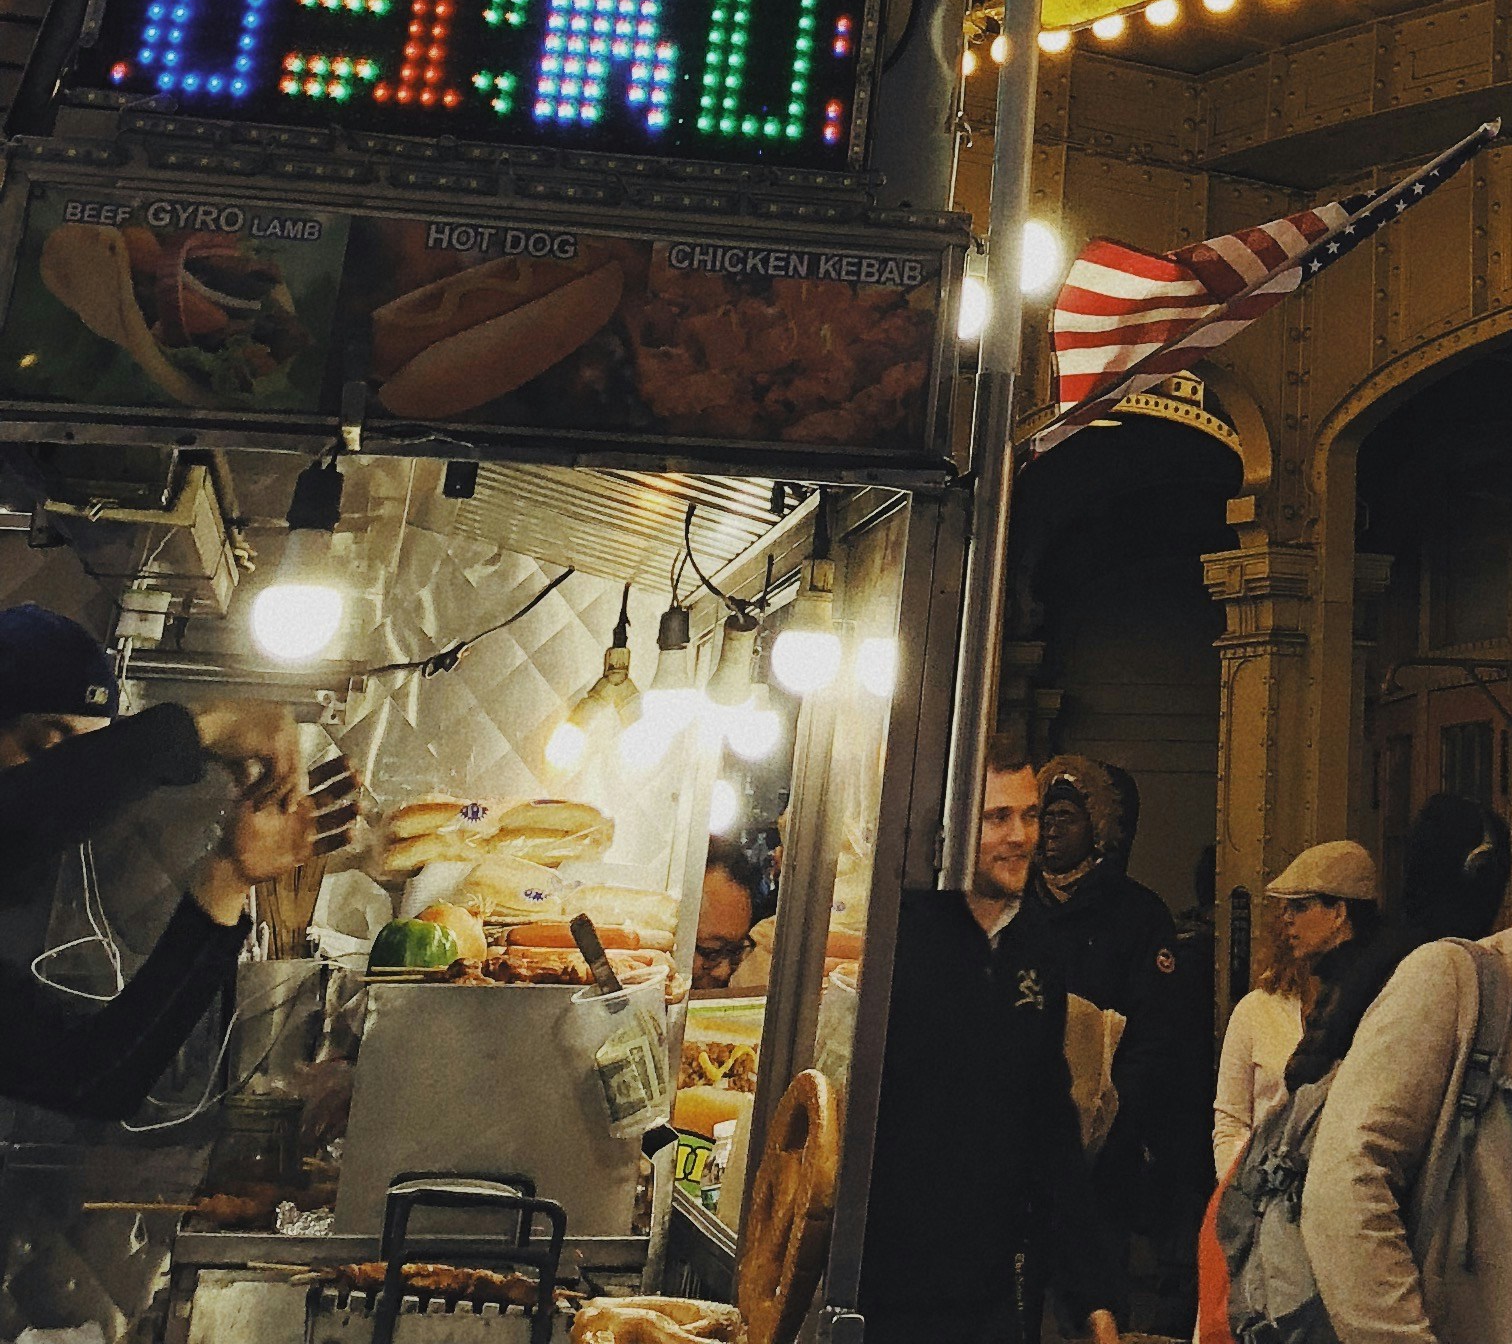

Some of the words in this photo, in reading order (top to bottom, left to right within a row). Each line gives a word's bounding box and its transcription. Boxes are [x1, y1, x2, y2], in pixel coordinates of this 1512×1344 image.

[65, 201, 131, 226] BEEF
[148, 201, 245, 232] GYRO
[251, 218, 322, 241] LAMB
[427, 223, 497, 253] HOT
[504, 228, 578, 259] DOG
[669, 243, 809, 278] CHICKEN
[818, 257, 924, 287] KEBAB
